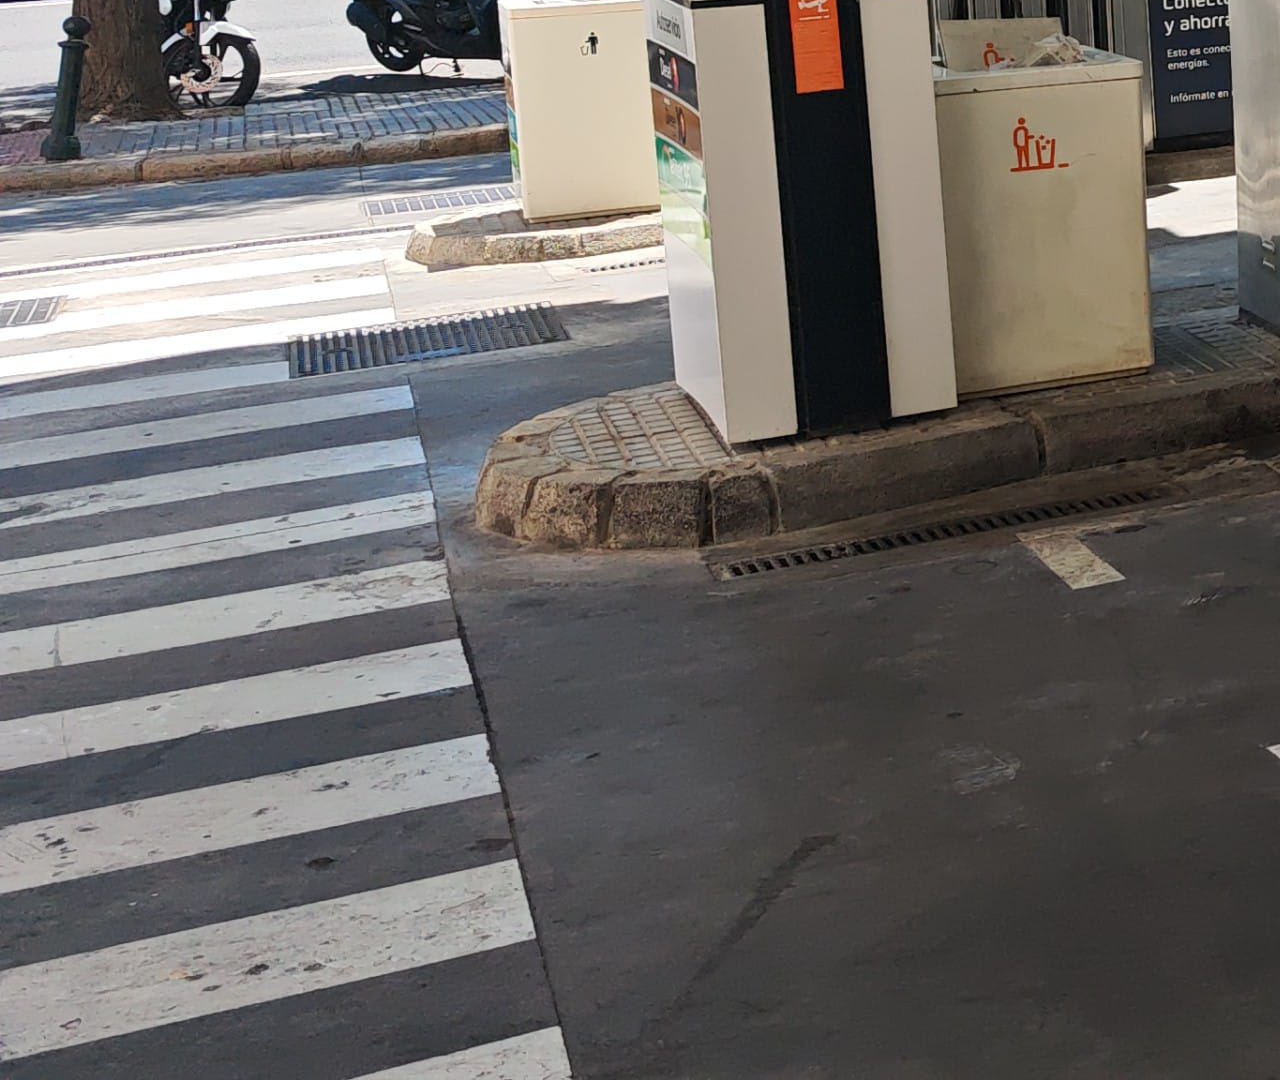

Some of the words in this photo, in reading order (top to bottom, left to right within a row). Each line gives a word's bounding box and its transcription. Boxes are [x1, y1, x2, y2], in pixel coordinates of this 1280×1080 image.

[1164, 20, 1174, 36] y
[1167, 48, 1188, 58] Esto
[1190, 48, 1200, 56] es
[1170, 91, 1215, 103] Infórmate
